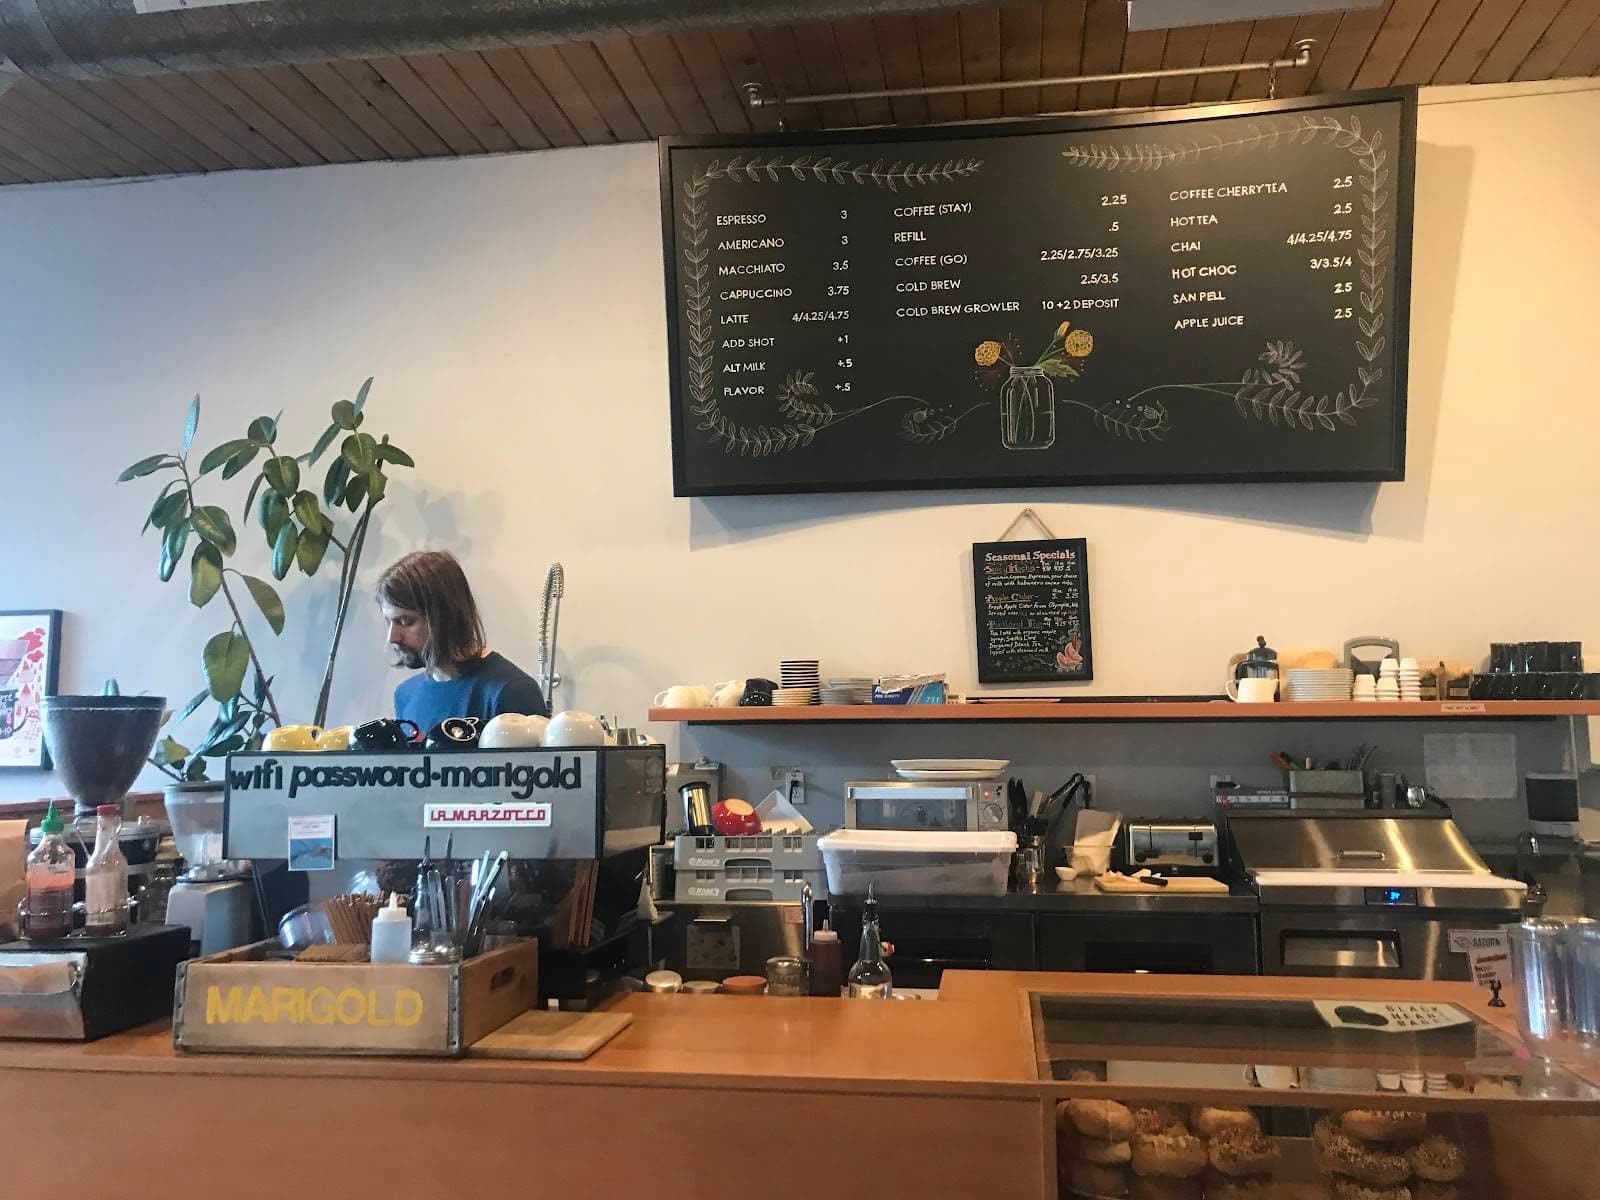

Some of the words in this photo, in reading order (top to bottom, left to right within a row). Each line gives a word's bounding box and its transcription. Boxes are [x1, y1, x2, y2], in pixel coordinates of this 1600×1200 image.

[1332, 175, 1353, 189] 2.5
[1101, 194, 1128, 206] 2.25
[1169, 188, 1214, 201] COFFEE
[840, 209, 848, 219] 3
[893, 204, 936, 218] COFFEE
[938, 201, 973, 216] (STAY)
[1332, 202, 1353, 215] 2.5
[716, 213, 767, 226] ESPRESSO
[1108, 221, 1120, 232] .5
[841, 235, 849, 245] 3
[893, 230, 927, 243] REFILL
[1286, 229, 1353, 246] 4/4.25/4.75
[718, 237, 785, 251] AMERICANO
[1170, 241, 1201, 252] CHAI
[894, 255, 937, 267] COFFEE
[939, 253, 968, 267] (GO)
[1040, 247, 1119, 261] 2.25/2.75/3.25
[718, 262, 786, 276] MACCHIATO
[832, 260, 849, 271] 3.5
[1309, 256, 1352, 270] 3/3.5/4
[1172, 266, 1197, 280] HOT
[1198, 264, 1237, 277] CHOC
[895, 281, 928, 293] COLD
[930, 279, 962, 291] BREW
[1080, 273, 1119, 286] 2.5/3.5
[719, 287, 793, 301] CAPPUCCINO
[827, 285, 850, 296] 3.75
[1333, 281, 1353, 294] 2.5
[1172, 292, 1197, 305] SAN
[1199, 290, 1226, 302] PELL
[895, 306, 928, 318] COLD
[930, 303, 962, 316] BREW
[963, 301, 1020, 314] GROWLER
[1041, 300, 1055, 311] 10
[1056, 299, 1071, 310] +2
[1073, 298, 1119, 310] DEPOSIT
[720, 314, 750, 325] LATTE
[791, 310, 850, 322] 4/4.25/4.75
[1333, 307, 1353, 320] 2.5
[1173, 317, 1209, 330] APPLE
[1211, 315, 1245, 328] JUICE
[722, 339, 746, 349] ADD
[748, 337, 775, 347] SHOT
[837, 334, 849, 344] +1
[722, 363, 742, 373] ALT
[743, 361, 767, 373] MILK
[723, 385, 765, 397] FLAVOR
[834, 382, 852, 392] +.5
[984, 551, 1031, 562] Seasonal
[1032, 549, 1076, 563] Specials
[231, 758, 283, 791] wifi
[205, 985, 424, 1027] MARIGOLD
